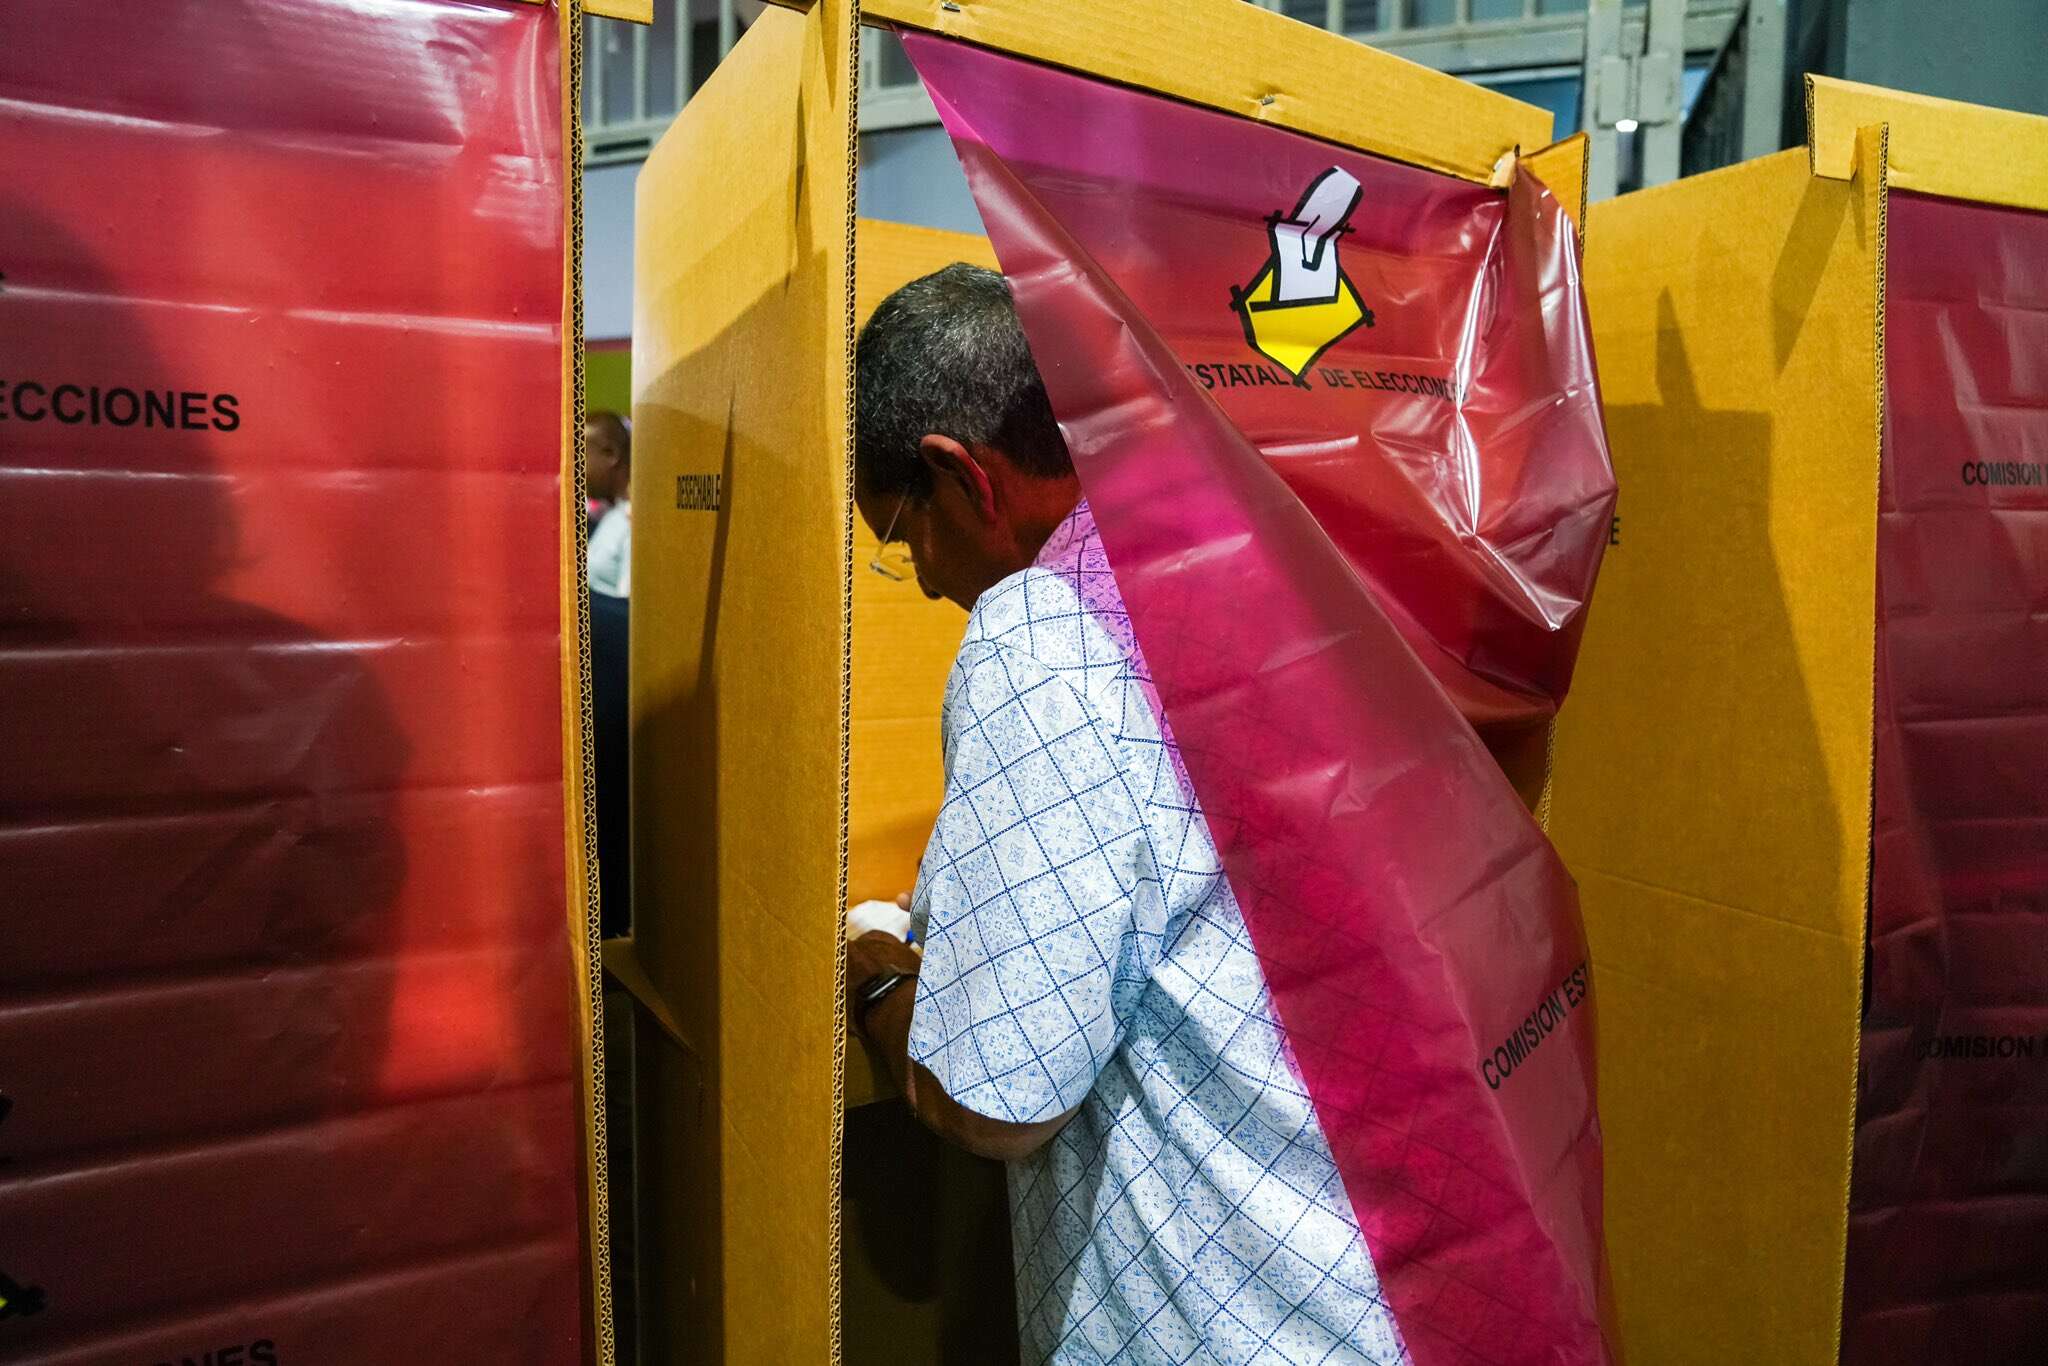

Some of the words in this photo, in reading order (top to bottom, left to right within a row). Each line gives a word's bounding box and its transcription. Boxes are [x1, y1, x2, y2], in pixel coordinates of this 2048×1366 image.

[1185, 363, 1290, 390] STATAL
[1319, 367, 1354, 388] DE
[1962, 461, 2042, 486] COMISION
[1482, 989, 1567, 1090] COMISION
